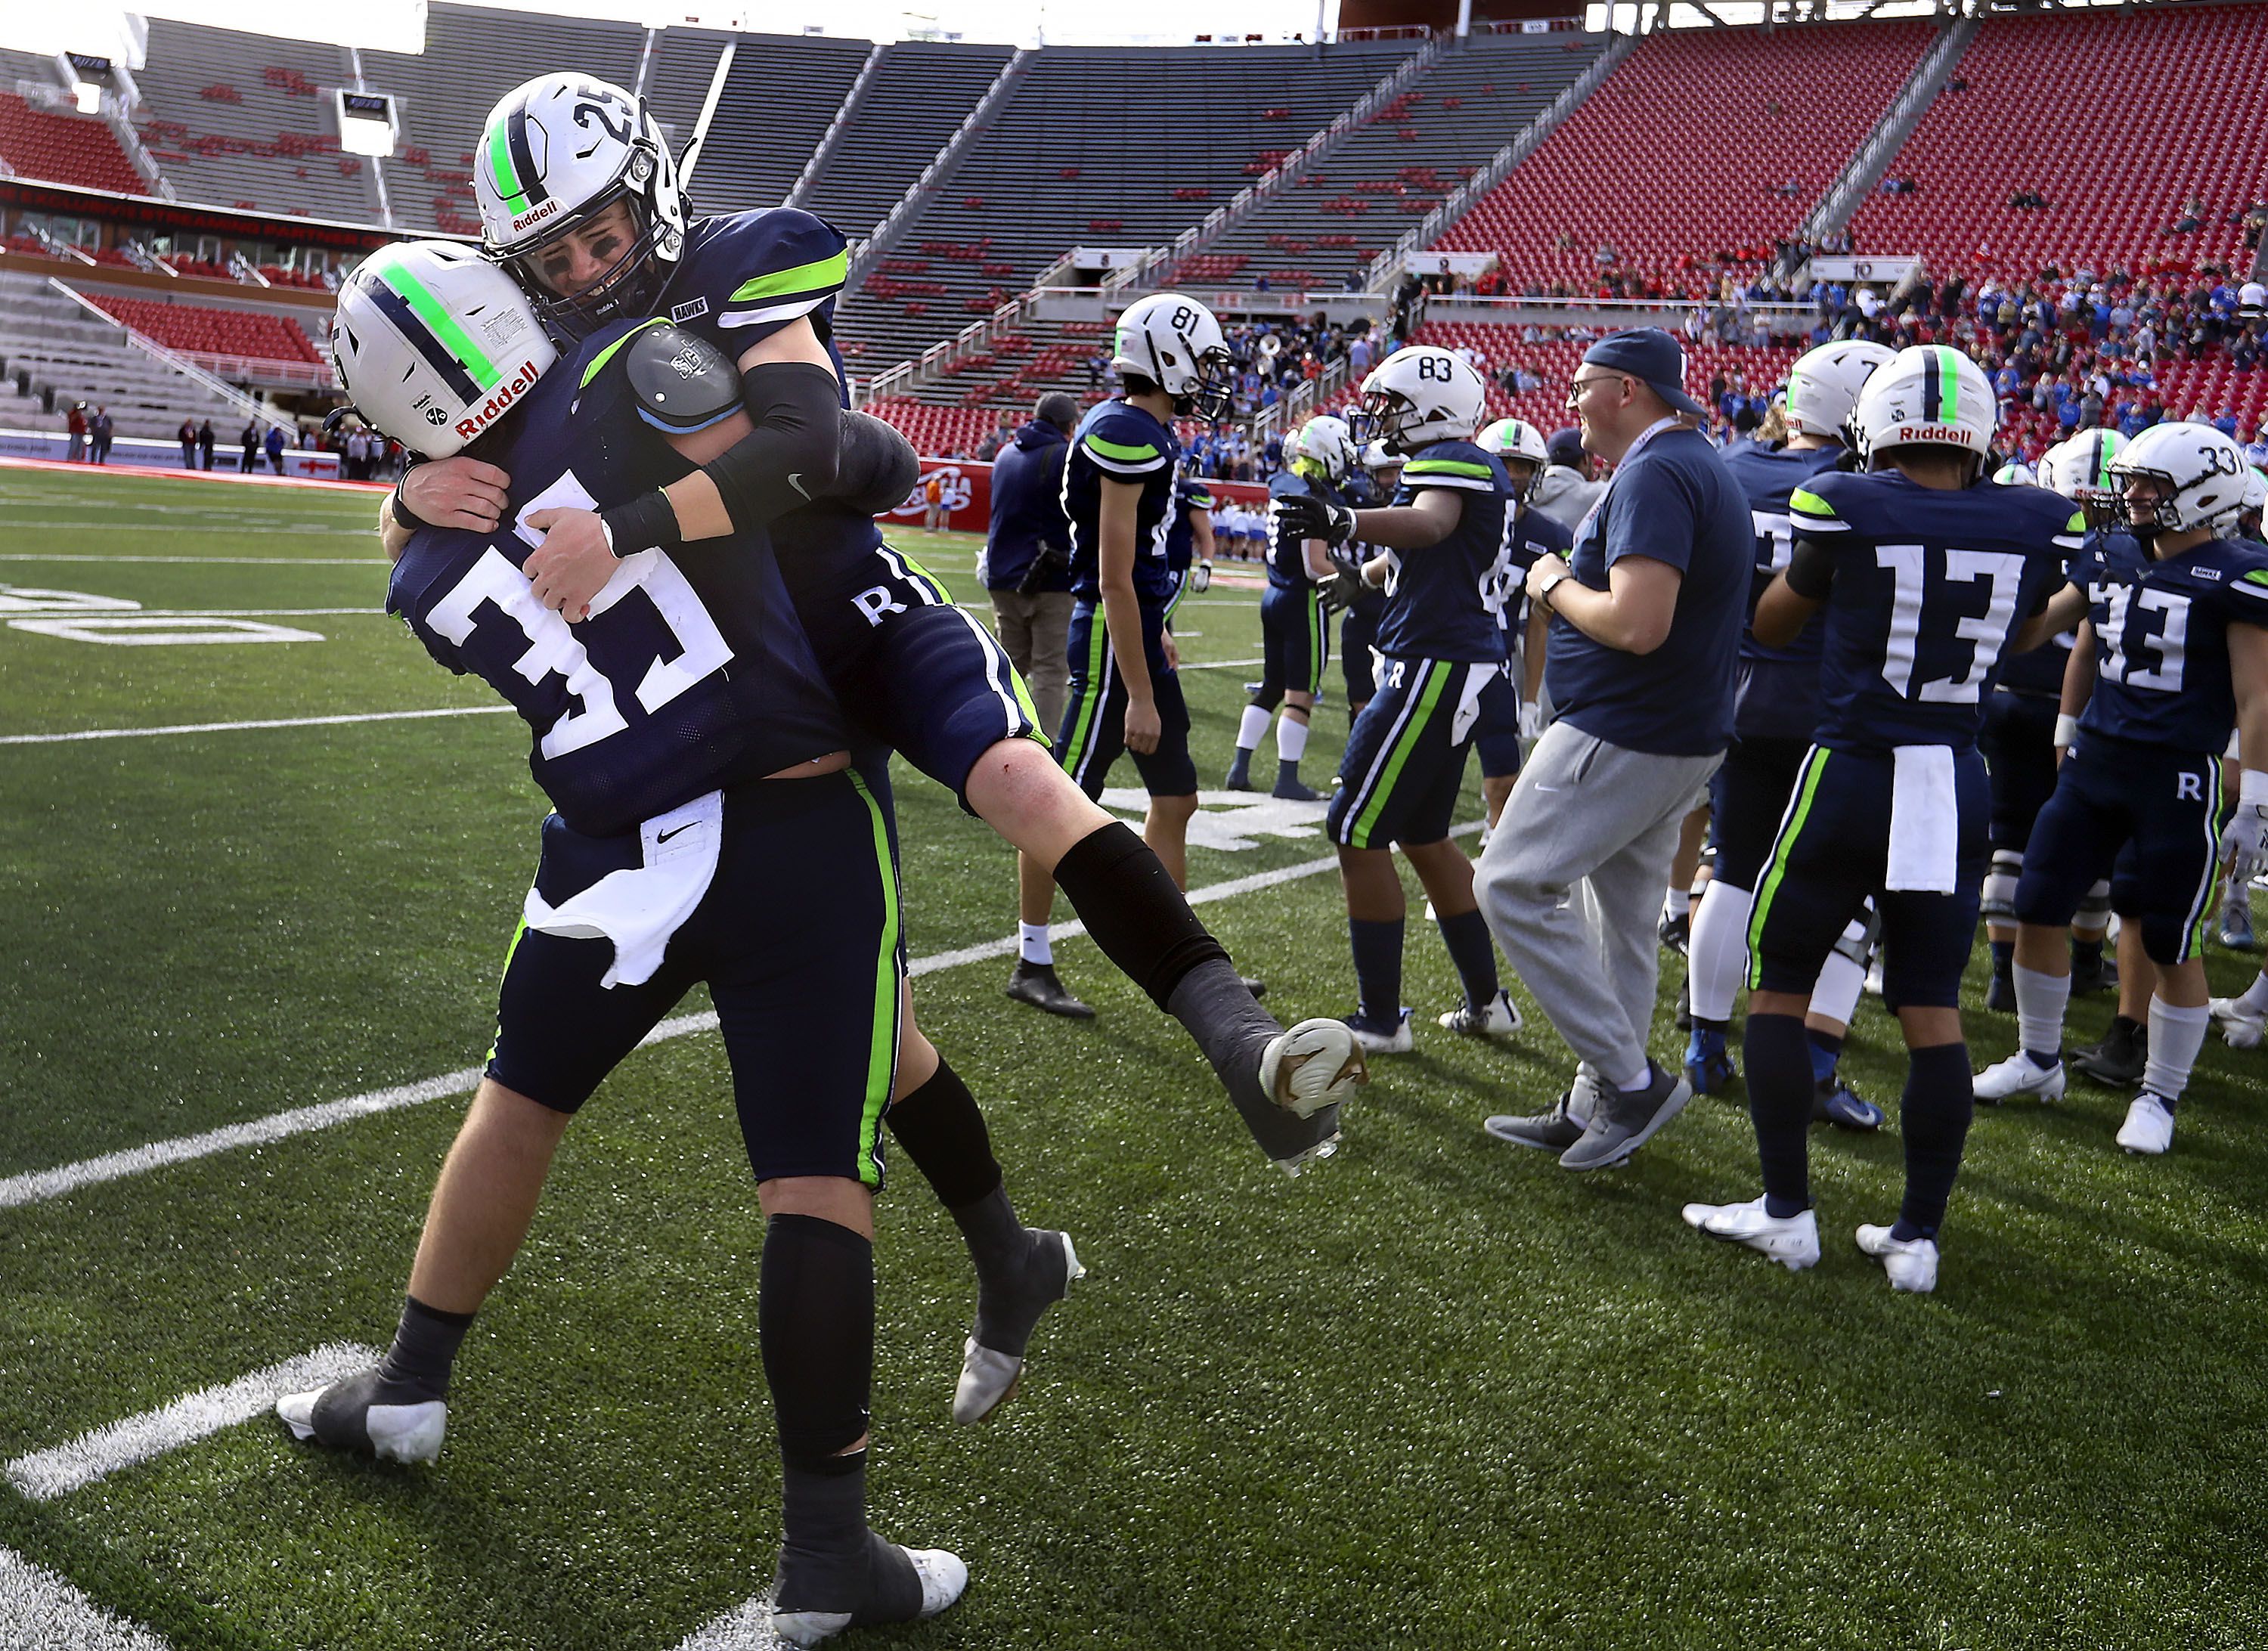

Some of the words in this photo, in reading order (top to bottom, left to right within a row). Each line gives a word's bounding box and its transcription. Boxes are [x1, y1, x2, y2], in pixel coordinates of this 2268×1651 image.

[573, 84, 634, 146] 25
[513, 201, 558, 231] Riddell
[674, 299, 706, 321] HAWKS
[1171, 306, 1199, 336] 81
[1419, 357, 1452, 383] 83
[455, 361, 539, 440] Riddell
[1899, 426, 1972, 445] Riddell
[2198, 447, 2236, 475] 33
[850, 585, 908, 627] R
[1876, 544, 2027, 704] 13
[2088, 581, 2192, 693] 33
[1388, 661, 1405, 689] R
[2177, 771, 2202, 801] R
